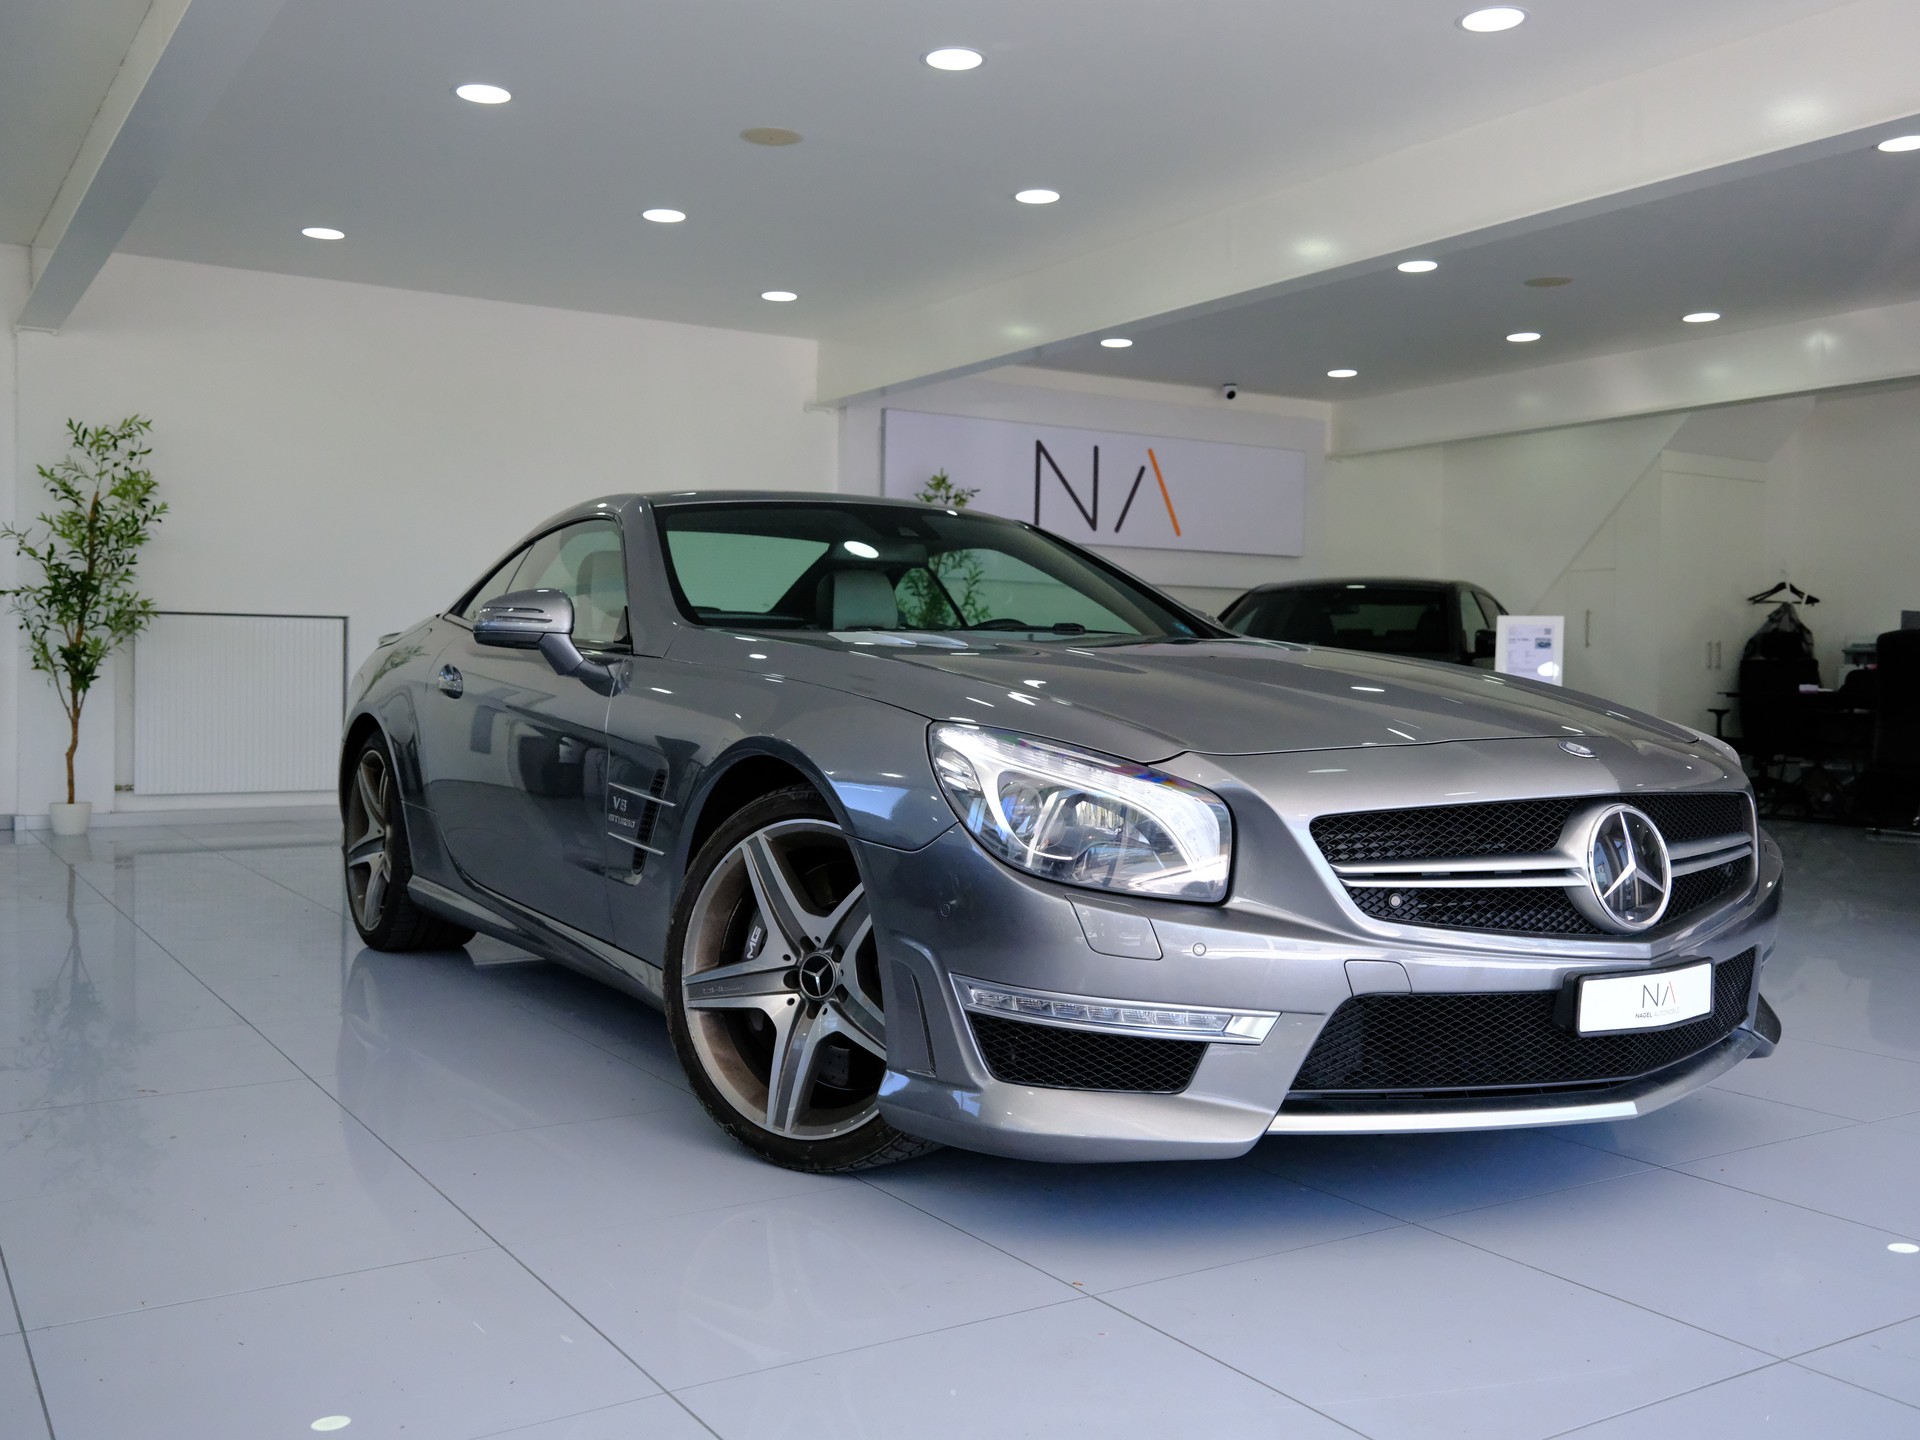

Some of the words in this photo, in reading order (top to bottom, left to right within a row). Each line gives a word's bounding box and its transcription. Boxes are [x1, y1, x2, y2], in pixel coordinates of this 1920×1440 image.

[1033, 439, 1182, 538] NA
[746, 925, 762, 959] MG
[1641, 980, 1676, 1009] NA
